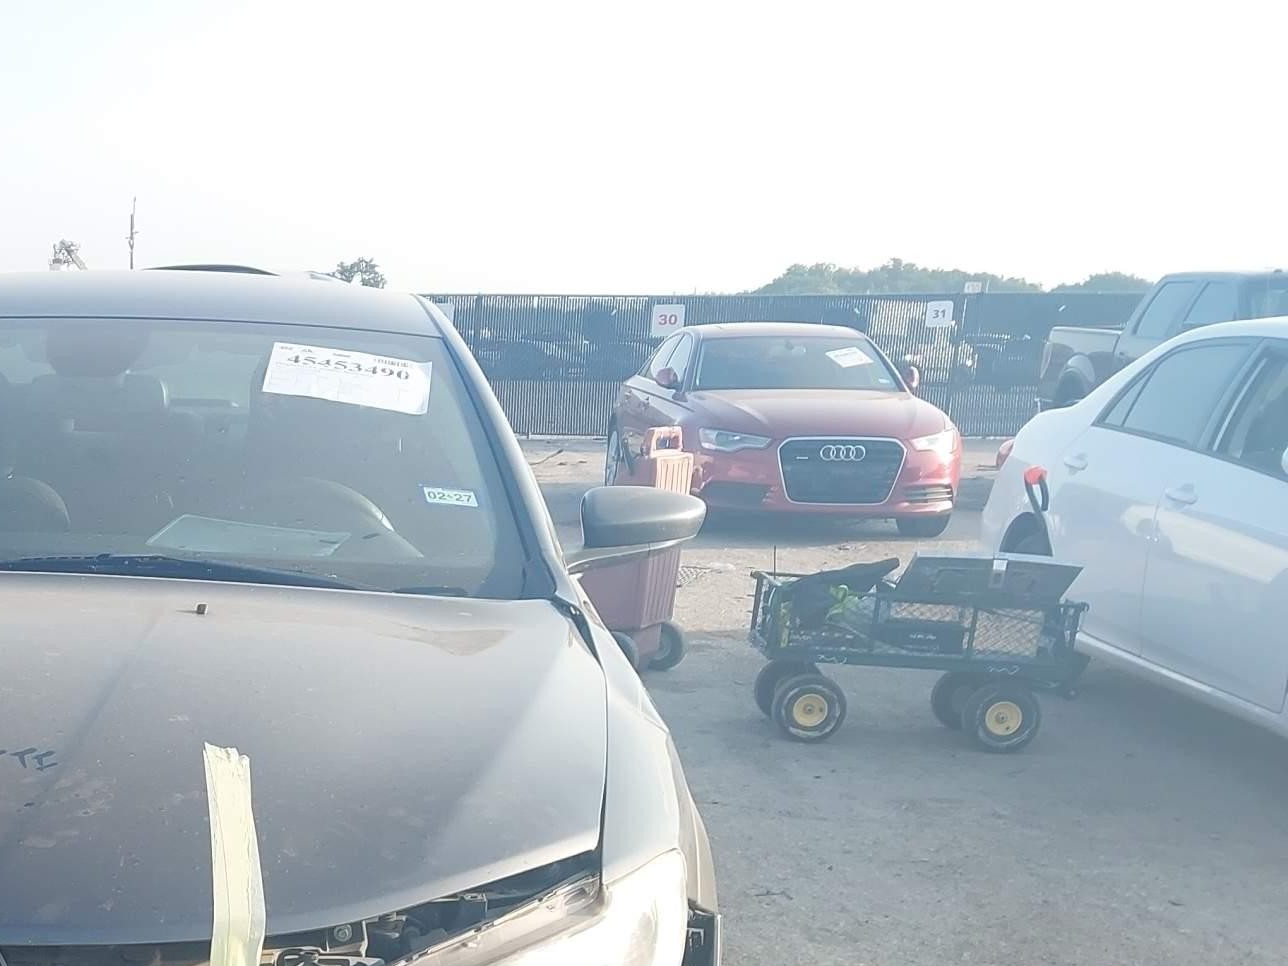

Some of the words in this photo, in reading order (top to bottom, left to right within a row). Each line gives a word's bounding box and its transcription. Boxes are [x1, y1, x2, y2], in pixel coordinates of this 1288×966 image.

[658, 313, 678, 326] 30
[932, 308, 947, 319] 31
[287, 354, 411, 380] 45453490
